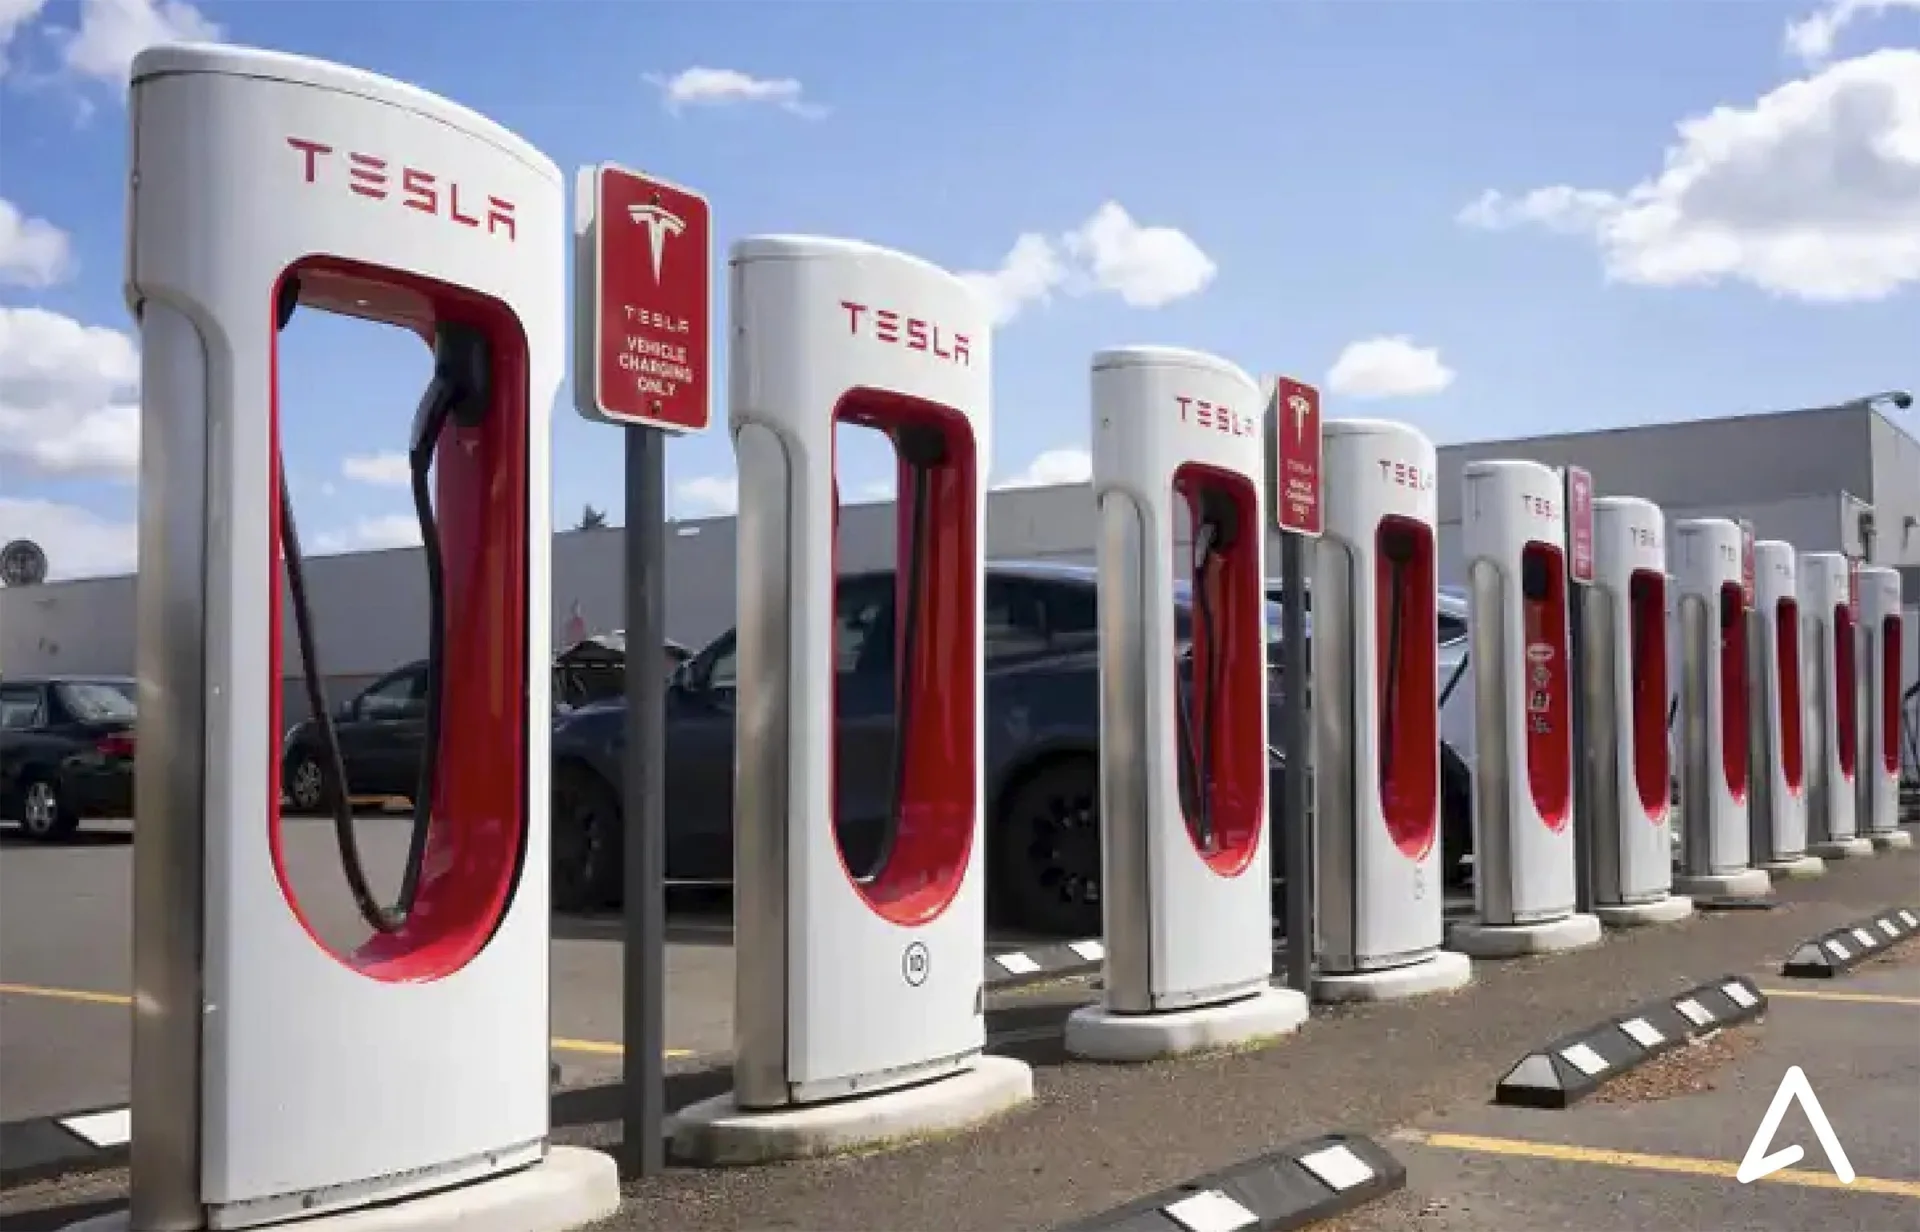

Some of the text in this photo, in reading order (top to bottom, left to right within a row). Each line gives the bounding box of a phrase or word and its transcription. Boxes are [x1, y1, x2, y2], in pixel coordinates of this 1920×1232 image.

[286, 136, 516, 242] TESLA
[624, 305, 689, 333] TESLA
[840, 300, 969, 366] TESLA
[627, 336, 687, 364] VEHICLE
[618, 353, 692, 384] CHARGING
[637, 377, 676, 396] ONLY
